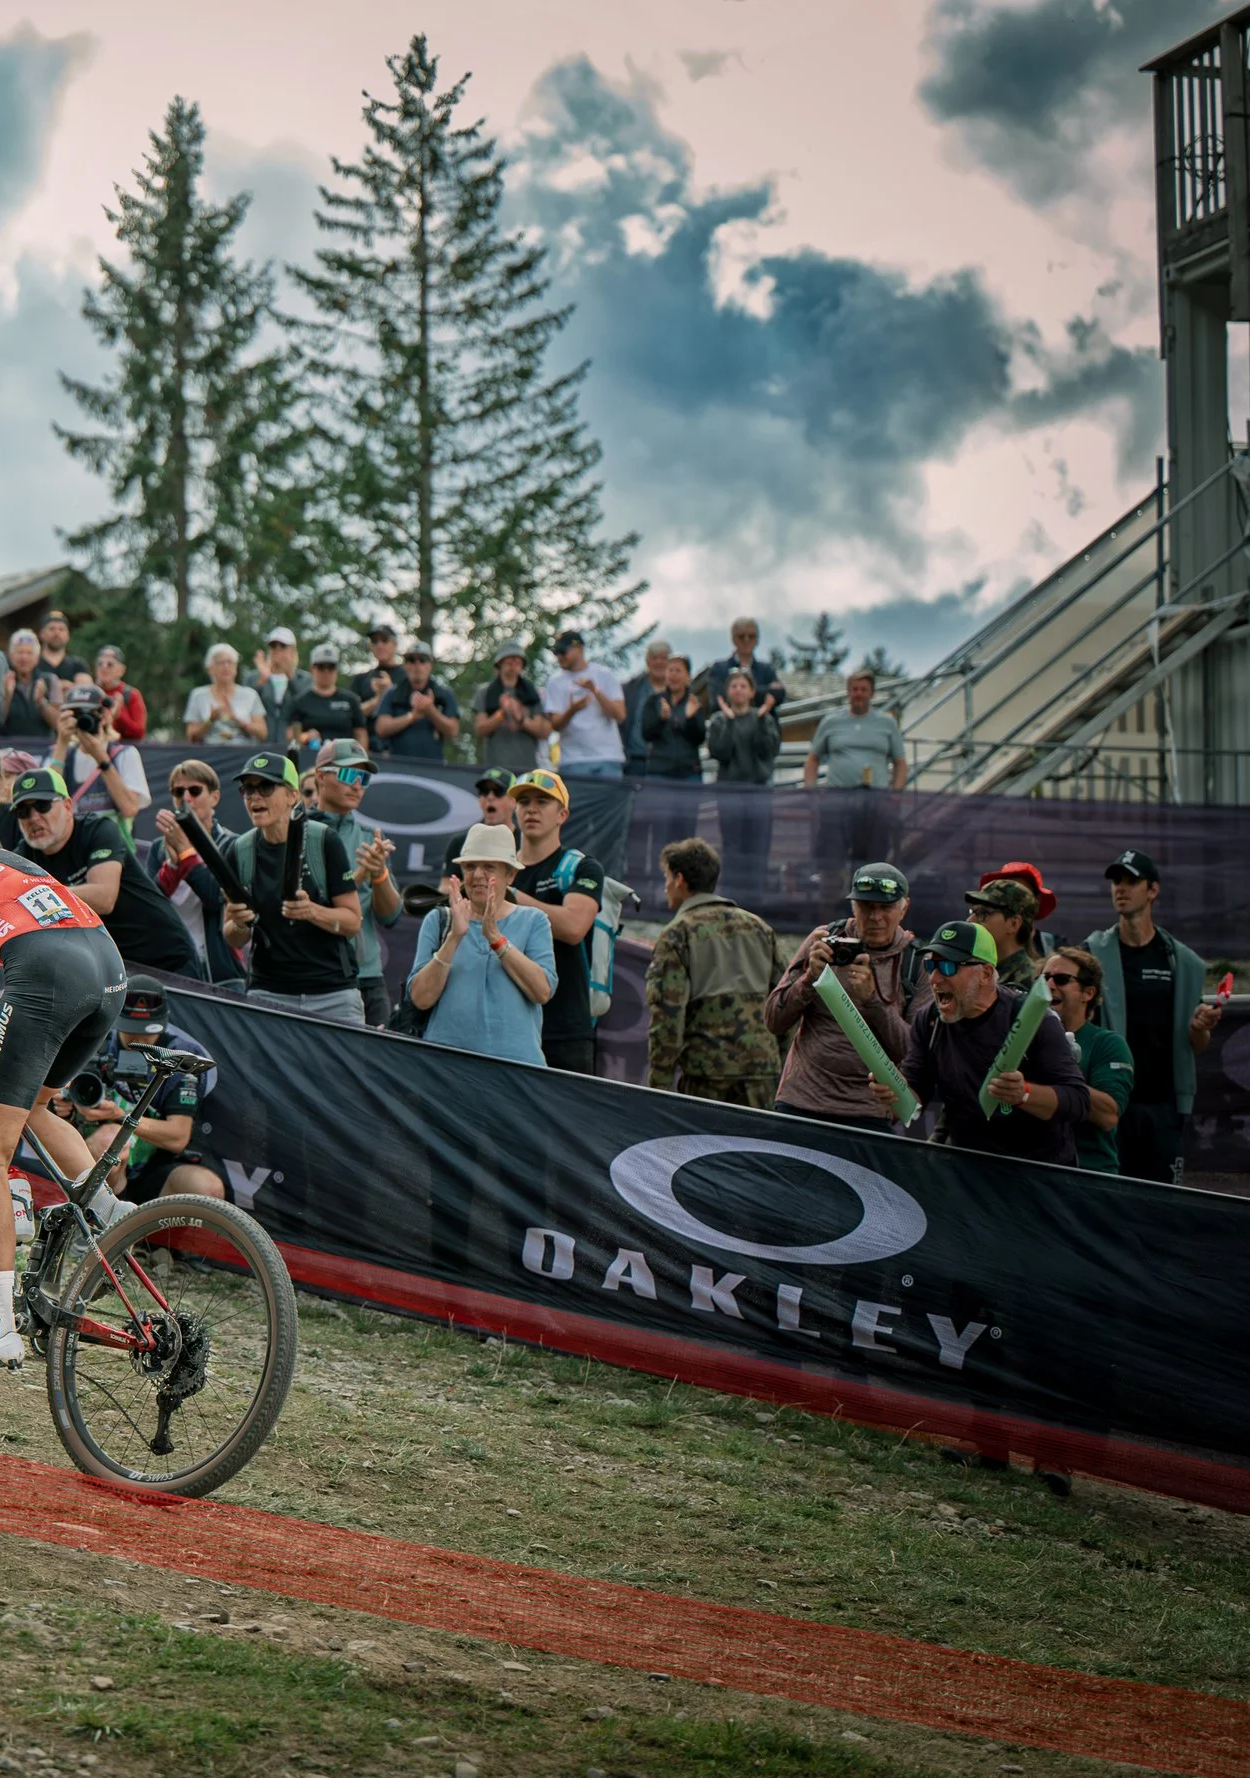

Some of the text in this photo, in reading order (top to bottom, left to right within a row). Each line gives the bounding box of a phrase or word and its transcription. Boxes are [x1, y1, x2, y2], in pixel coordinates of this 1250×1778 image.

[32, 893, 61, 913] 11
[841, 993, 882, 1054] SWITZERLAND
[158, 1216, 203, 1229] DT SWISS
[53, 1369, 61, 1391] RACE
